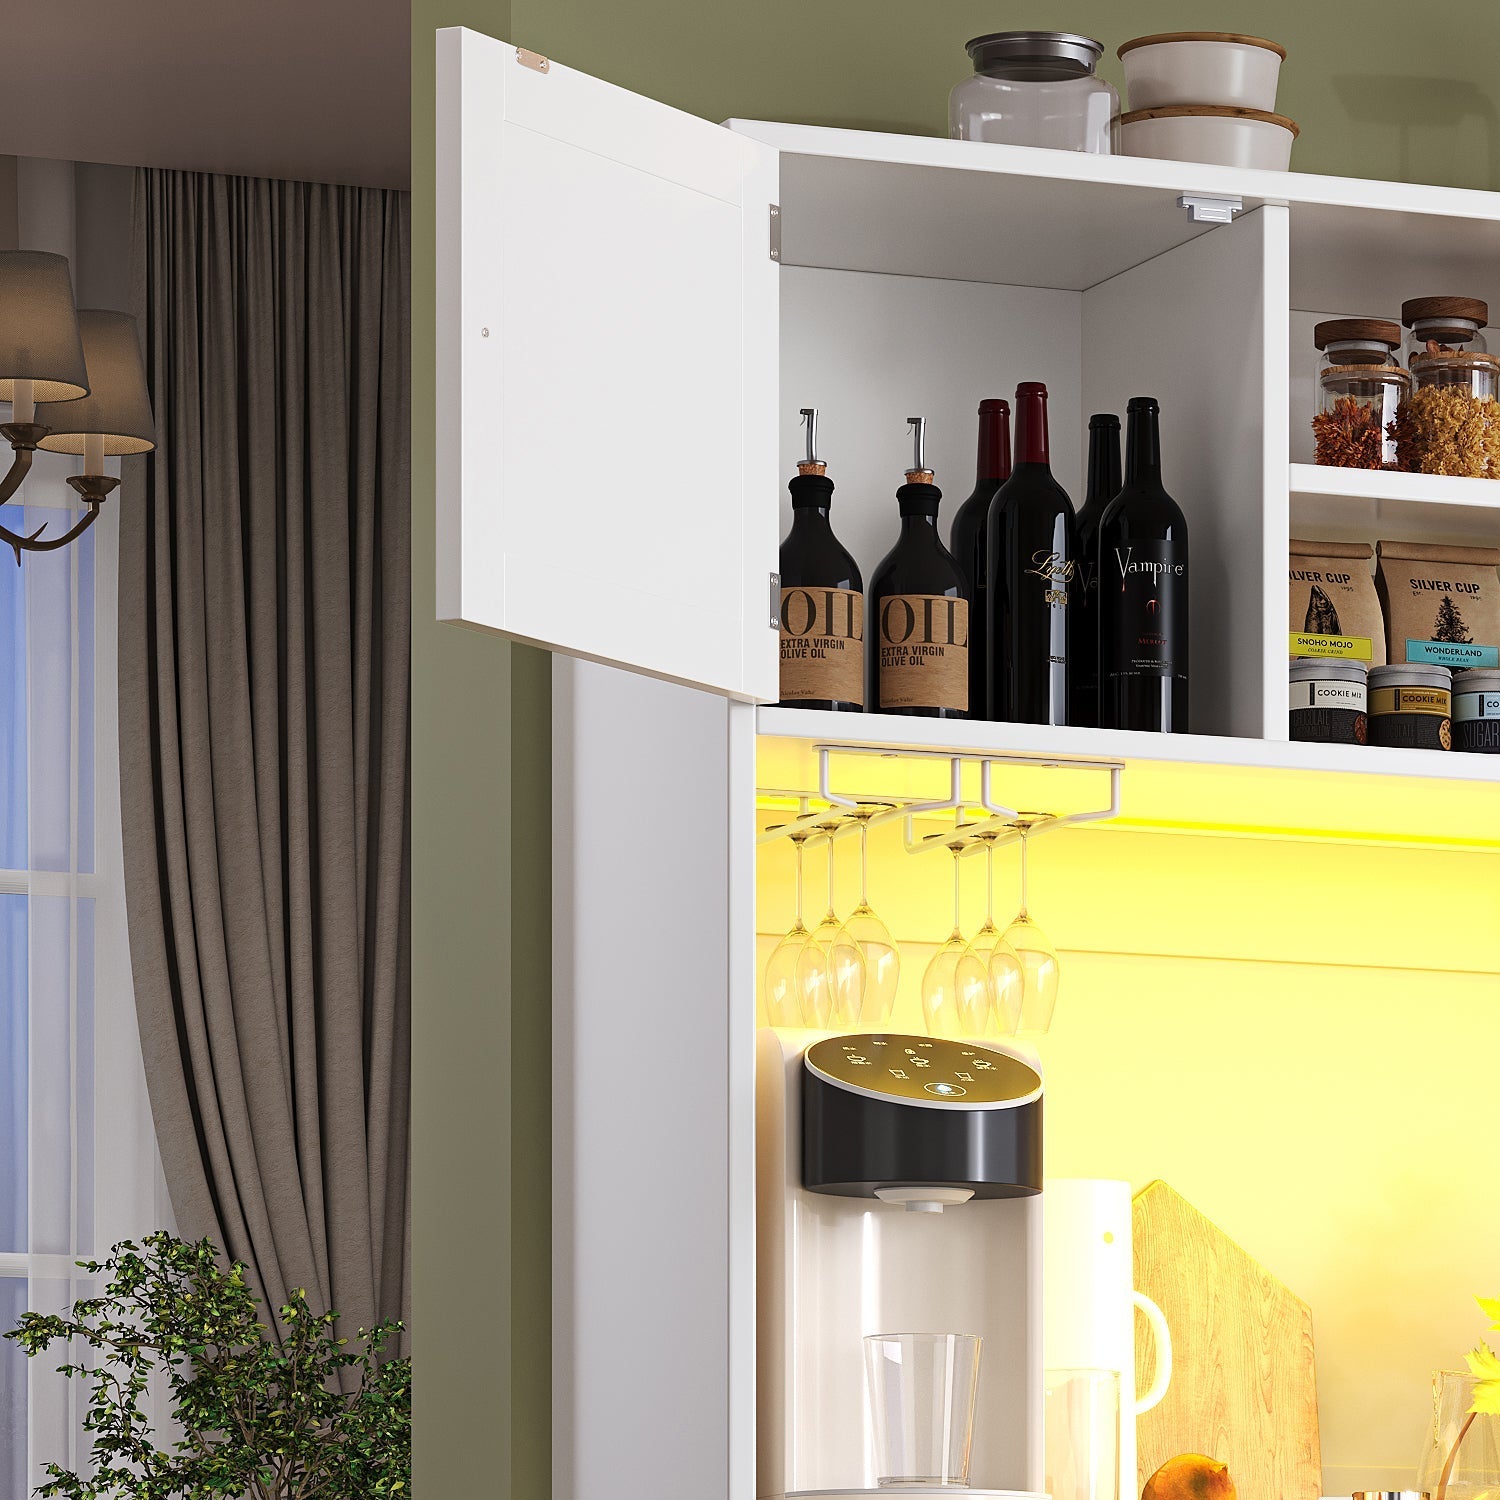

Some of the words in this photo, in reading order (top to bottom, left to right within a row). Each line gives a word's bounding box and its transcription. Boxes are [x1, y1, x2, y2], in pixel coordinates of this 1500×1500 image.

[1114, 547, 1185, 590] Vampire
[1289, 570, 1323, 582] ILVER
[1325, 573, 1351, 584] CUP
[1410, 579, 1451, 592] SILVER
[1455, 582, 1480, 594] CUP
[781, 590, 863, 642] OIL
[881, 598, 968, 649] OIL
[781, 639, 810, 649] EXTRA
[813, 639, 845, 650] VIRGIN
[1297, 637, 1327, 647] SNOHO
[1329, 640, 1353, 649] MOJO
[781, 649, 807, 659] OLIVE
[811, 649, 826, 659] OIL
[881, 647, 909, 657] EXTRA
[912, 646, 945, 657] VIRGIN
[1425, 646, 1483, 657] WONDERLAND
[881, 656, 906, 667] OLIVE
[910, 656, 925, 666] OIL
[1317, 689, 1349, 698] COOKIE
[1402, 695, 1434, 703] COOKIE
[1436, 696, 1447, 705] MIX
[1463, 721, 1499, 749] SUGAR
